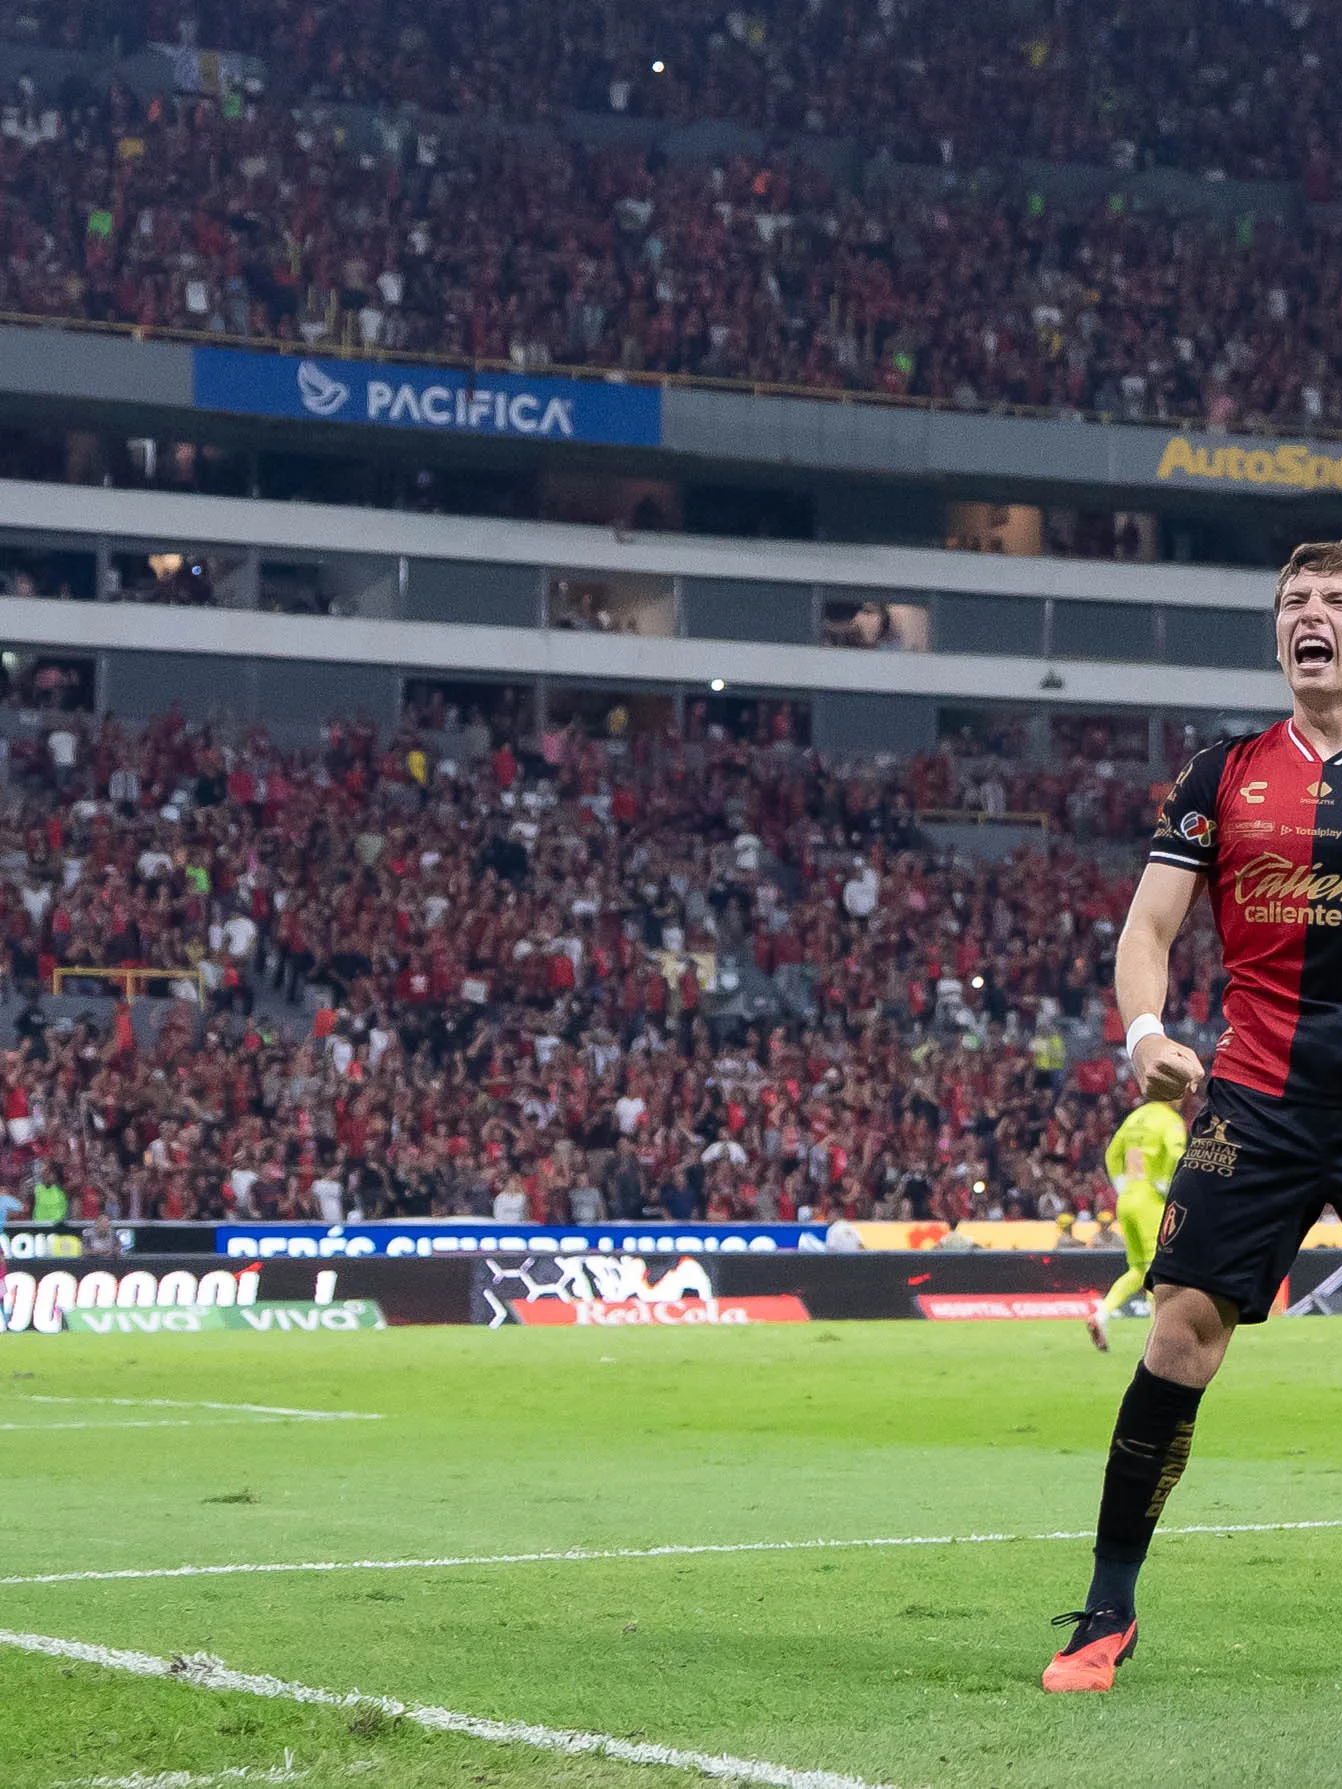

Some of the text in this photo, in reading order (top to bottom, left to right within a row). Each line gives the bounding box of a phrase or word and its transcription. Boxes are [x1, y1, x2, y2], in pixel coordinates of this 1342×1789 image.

[367, 381, 575, 437] PACIFICA
[1295, 826, 1342, 840] Totalplay
[1186, 1149, 1238, 1166] COUNTRY
